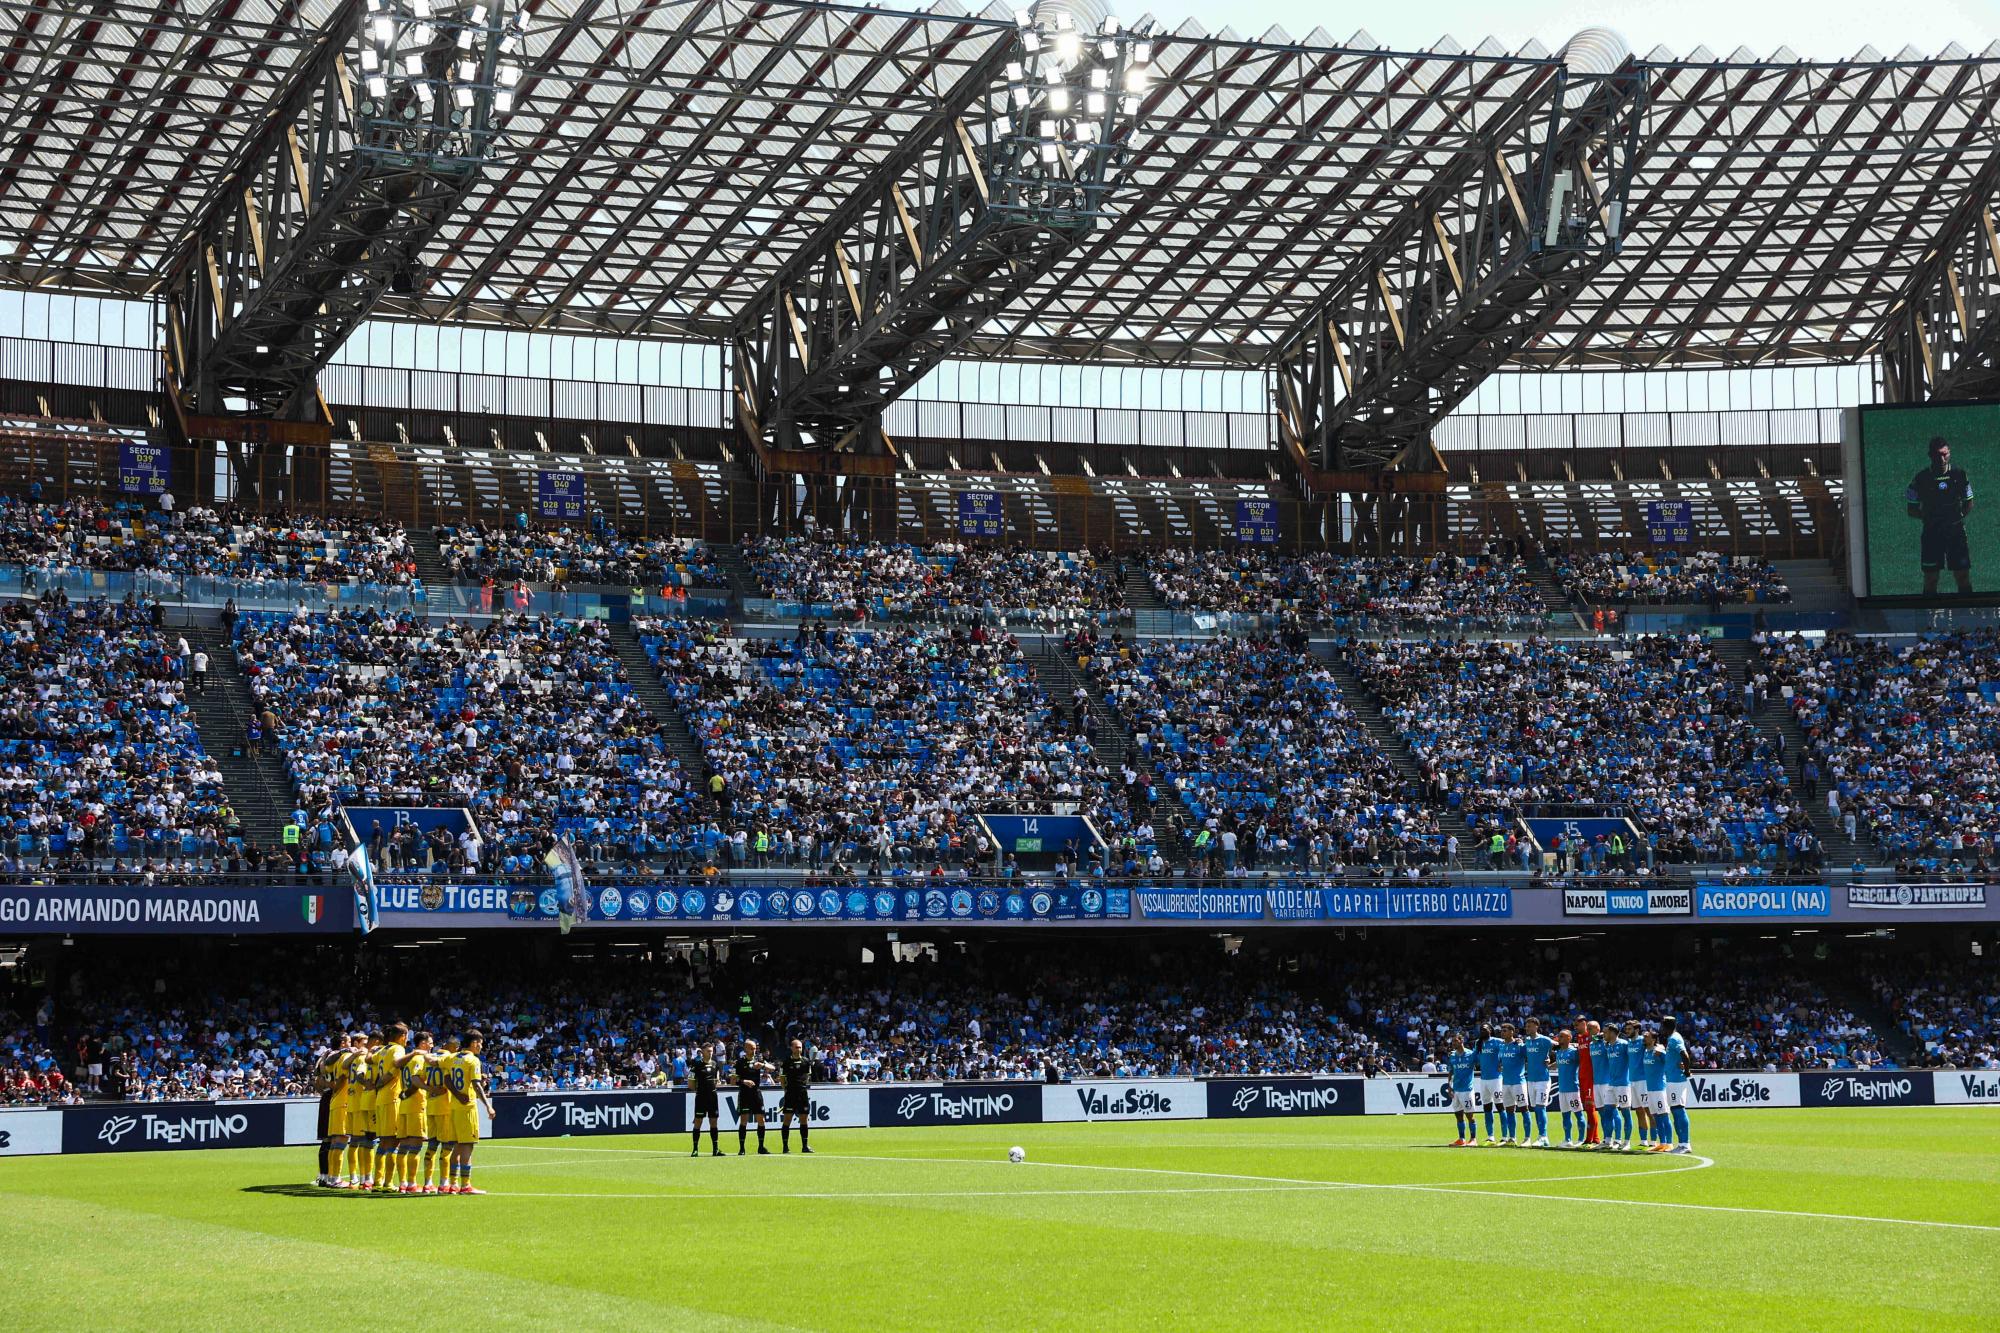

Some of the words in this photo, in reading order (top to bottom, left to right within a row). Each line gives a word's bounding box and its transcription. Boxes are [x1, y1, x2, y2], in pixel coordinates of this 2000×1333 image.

[130, 447, 161, 455] SECTOR
[124, 476, 140, 484] D27
[394, 811, 410, 827] 13
[1022, 818, 1039, 834] 14
[1564, 822, 1580, 836] 15
[376, 888, 418, 909] LUE
[445, 886, 508, 909] TIGER
[1202, 895, 1262, 913] SORRENTO
[1266, 890, 1322, 909] MODENA
[1334, 894, 1379, 913] CAPRI
[1393, 894, 1447, 912] VITERBO
[1453, 894, 1507, 912] CAIAZZO
[1566, 895, 1606, 909] NAPOLI
[1611, 895, 1643, 909] UNICO
[1649, 894, 1689, 908] AMORE
[1702, 892, 1785, 910] AGROPOLI
[1791, 889, 1826, 912] (NA)
[1849, 888, 1896, 902] CERCOLA
[1913, 886, 1985, 903] PARTENOPEA
[0, 898, 29, 922] GO
[34, 898, 139, 922] ARMANDO
[145, 898, 260, 922] MARADONA
[426, 1067, 444, 1088] 70
[1846, 1076, 1912, 1100] TRENTINO
[1960, 1074, 1986, 1099] Val
[1987, 1083, 1998, 1097] di
[1262, 1086, 1338, 1111] TRENTINO
[1396, 1082, 1425, 1109] Val
[1427, 1093, 1440, 1107] di
[1618, 1094, 1628, 1102] 20
[1689, 1078, 1717, 1102] Val
[1718, 1087, 1729, 1101] di
[1730, 1078, 1771, 1102] Sole
[930, 1093, 1014, 1119] TRENTINO
[1077, 1088, 1108, 1116] Val
[1111, 1097, 1124, 1113] di
[1126, 1088, 1172, 1114] Sole
[561, 1102, 654, 1129] TRENTINO
[142, 1114, 248, 1143] TRENTINO
